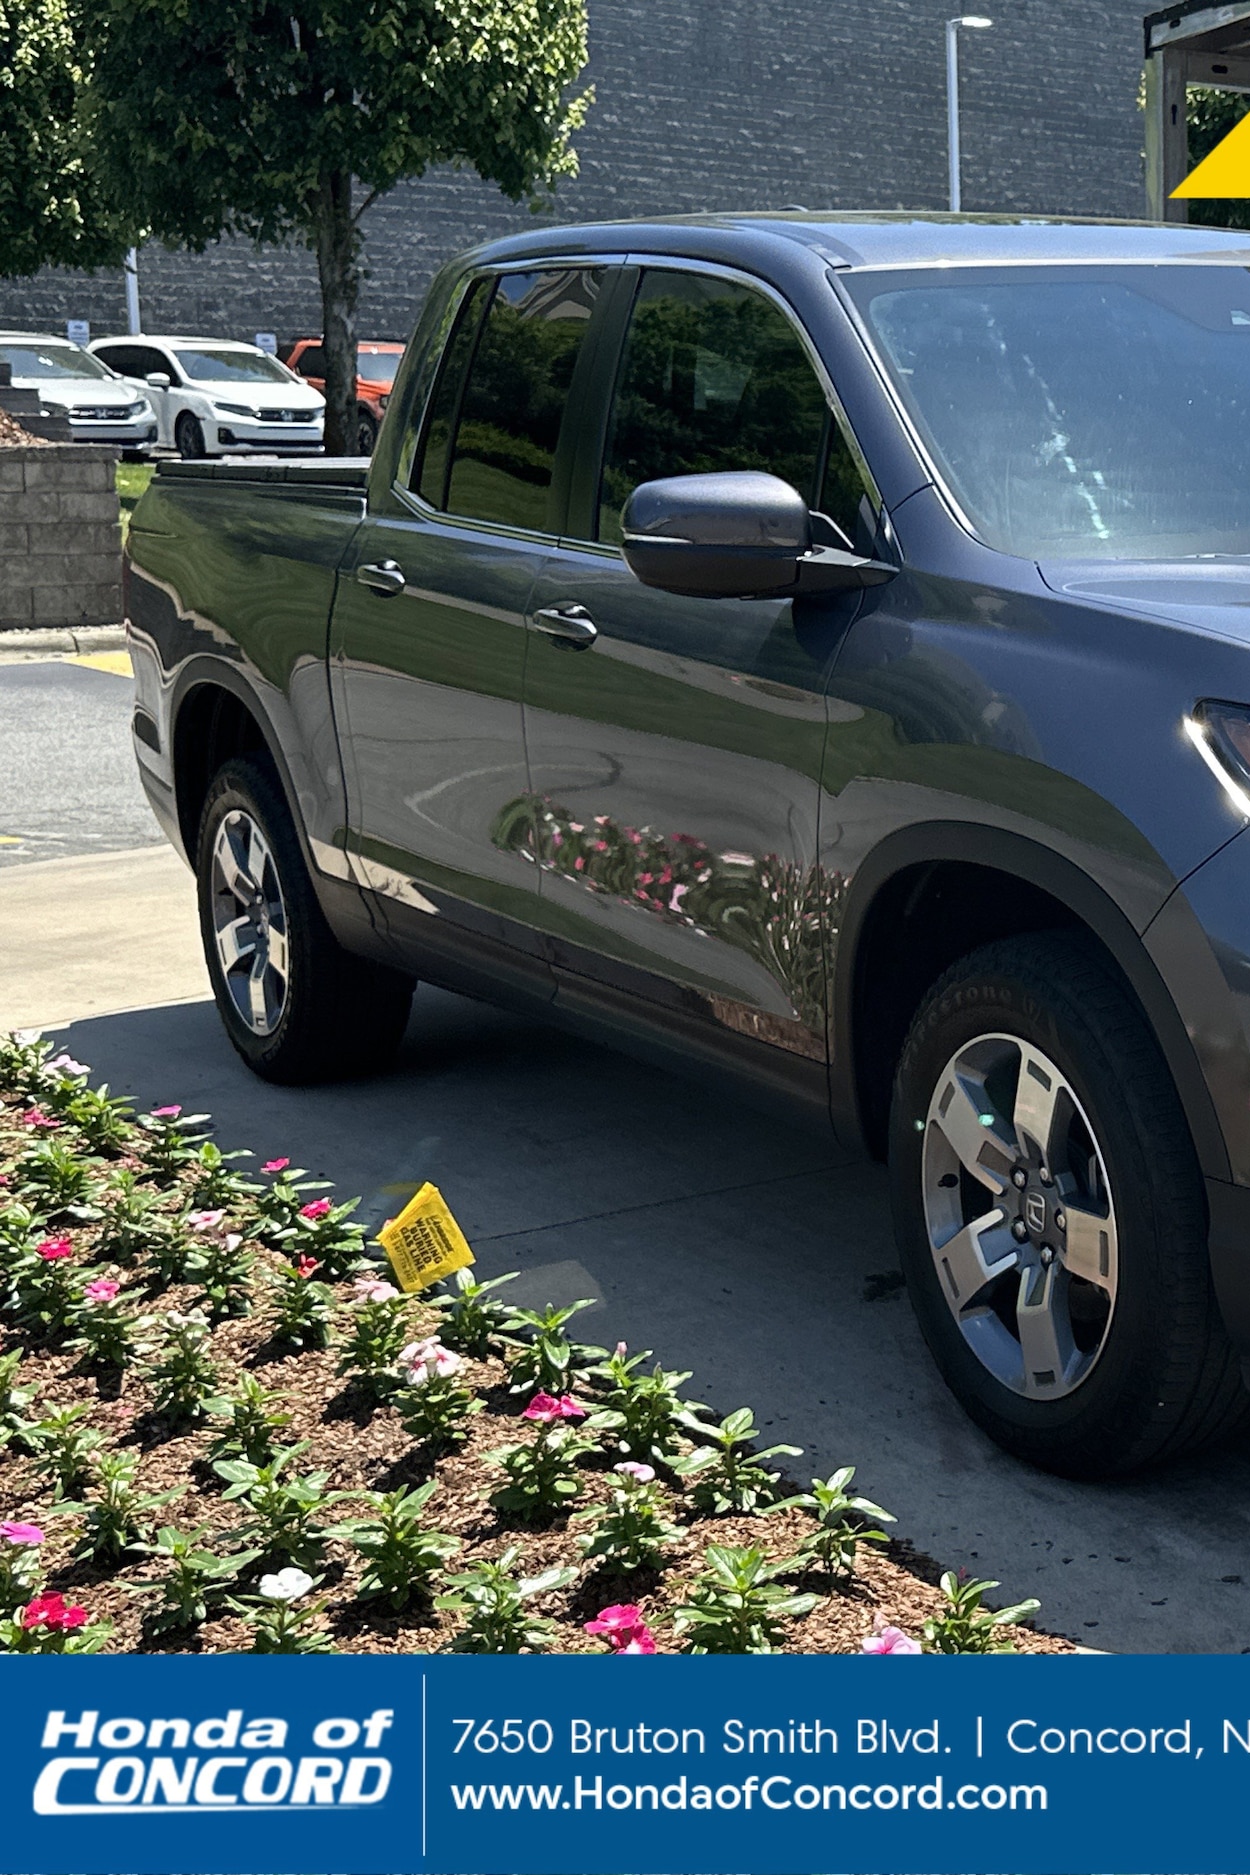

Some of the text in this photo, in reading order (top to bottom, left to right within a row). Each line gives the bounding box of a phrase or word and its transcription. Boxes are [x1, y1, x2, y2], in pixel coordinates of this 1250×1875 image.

[399, 1226, 414, 1248] GAS
[410, 1249, 426, 1272] LINE
[409, 1226, 432, 1264] BURIED
[415, 1217, 443, 1264] WARNING
